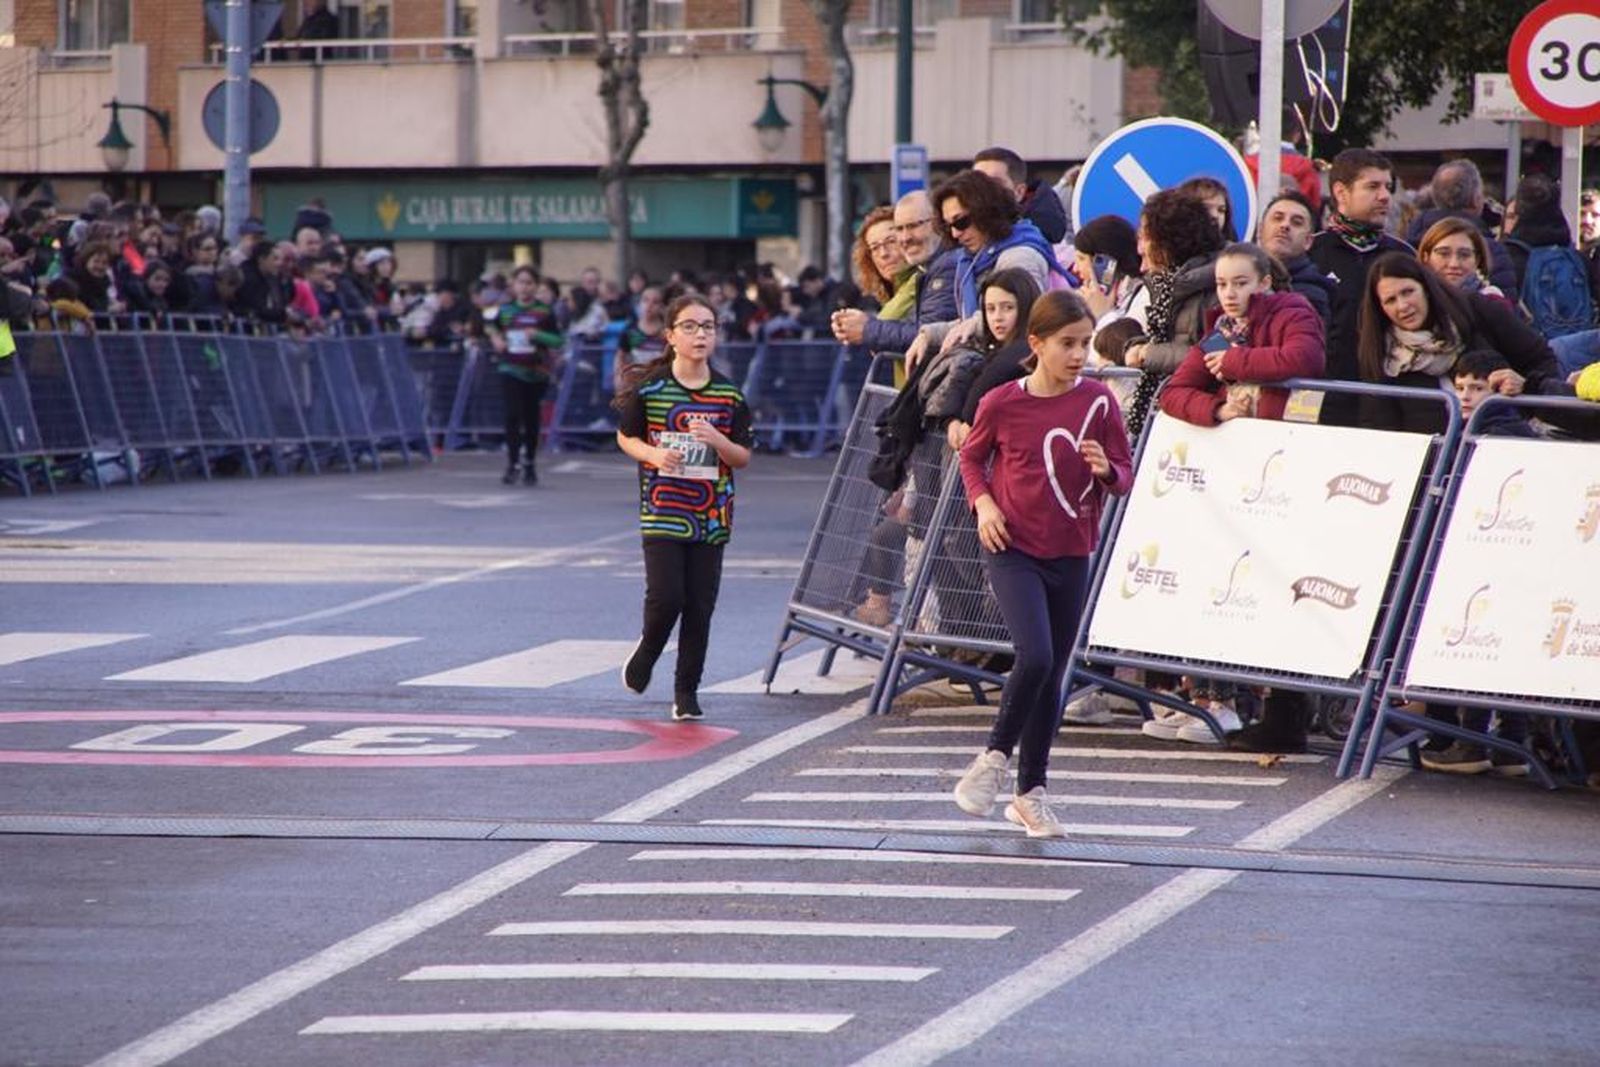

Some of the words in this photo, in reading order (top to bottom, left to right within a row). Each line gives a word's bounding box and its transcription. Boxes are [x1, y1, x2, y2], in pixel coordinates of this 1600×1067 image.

[1540, 41, 1600, 82] 30
[406, 196, 448, 231] CAJA
[451, 196, 506, 224] RURAL
[510, 196, 533, 224] DE
[1165, 466, 1207, 485] SETEL
[1133, 567, 1179, 588] SETEL
